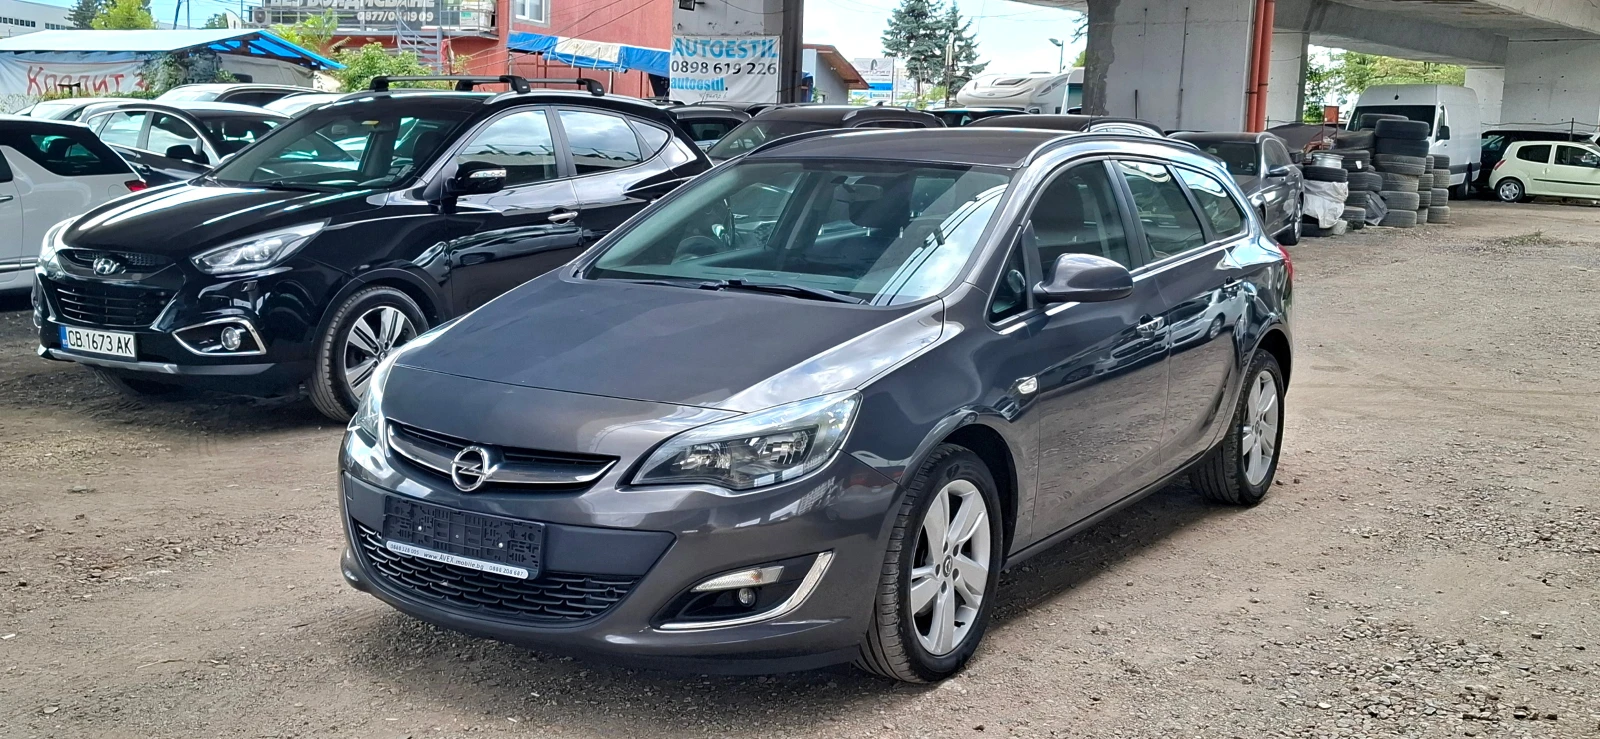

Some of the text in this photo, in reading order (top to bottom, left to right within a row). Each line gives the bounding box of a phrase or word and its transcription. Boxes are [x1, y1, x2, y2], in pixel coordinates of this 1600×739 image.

[671, 38, 778, 59] AUTOESTIL
[671, 60, 777, 75] 0898 619 226
[86, 333, 114, 352] 1673
[116, 336, 133, 355] AK
